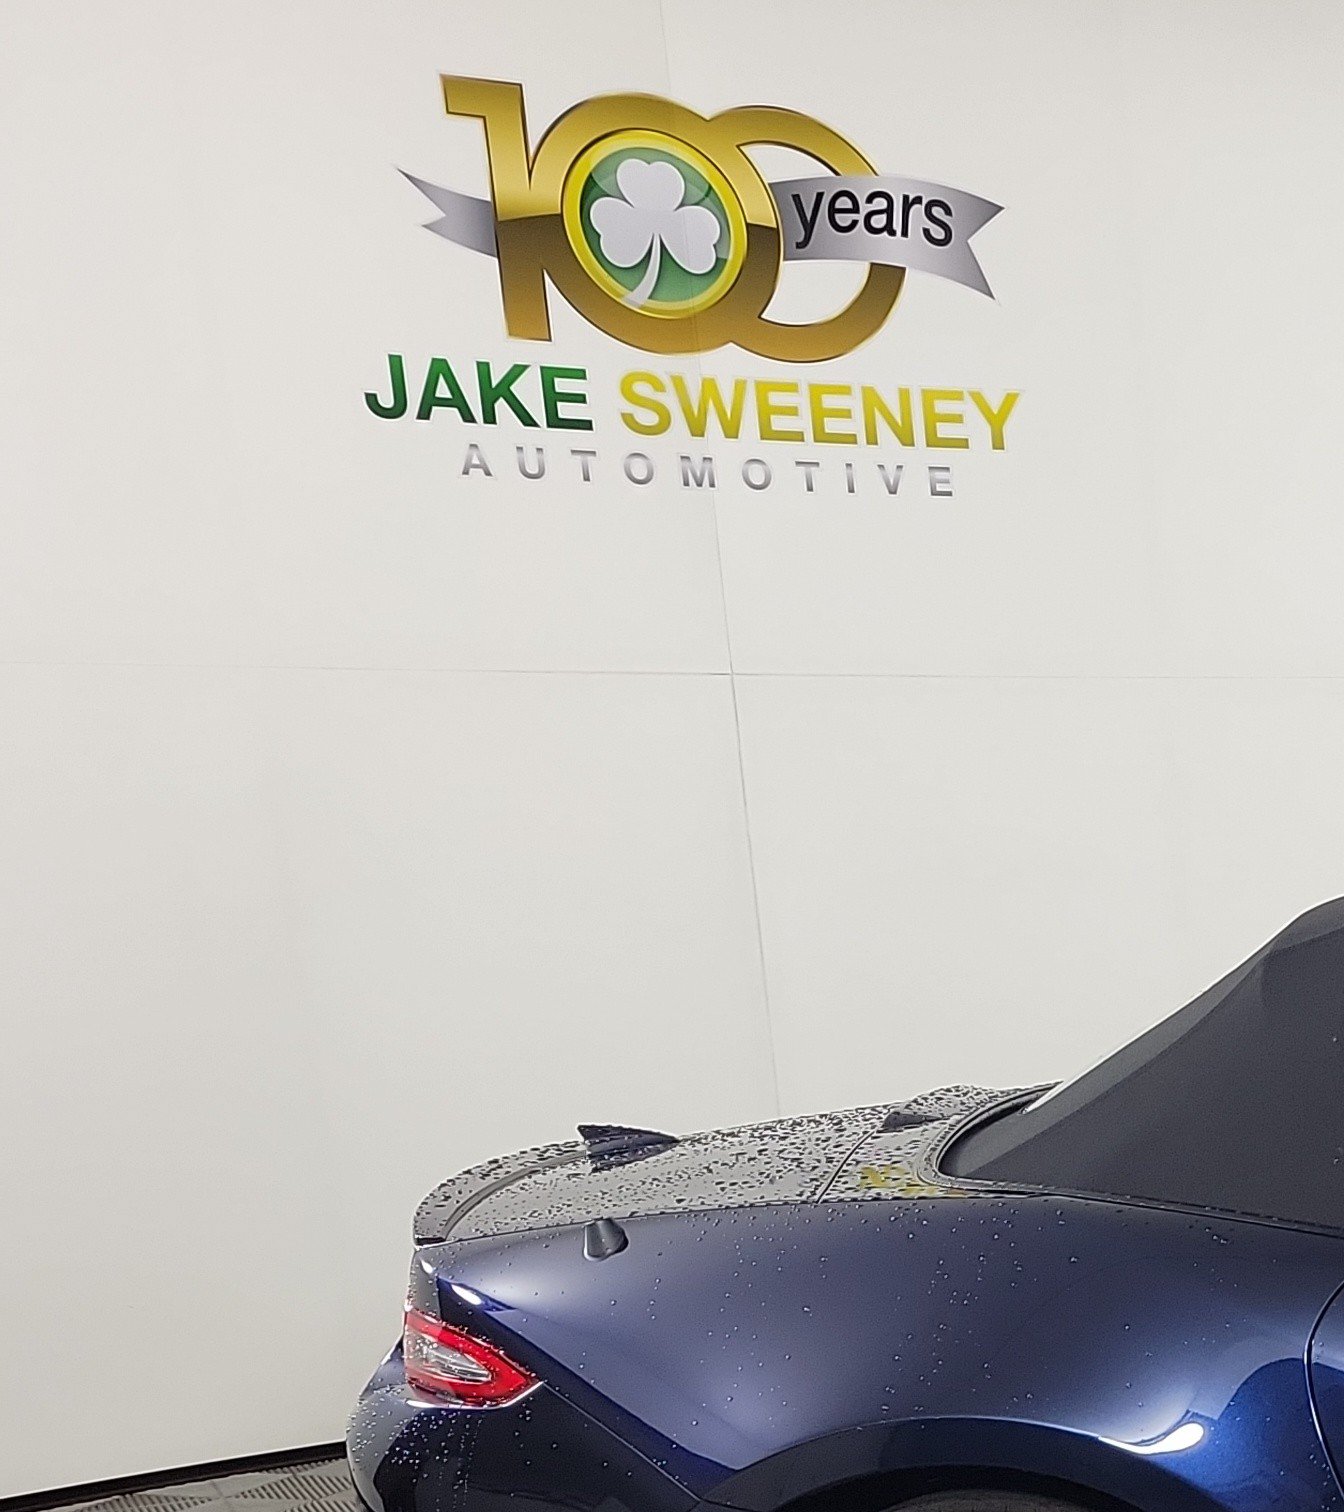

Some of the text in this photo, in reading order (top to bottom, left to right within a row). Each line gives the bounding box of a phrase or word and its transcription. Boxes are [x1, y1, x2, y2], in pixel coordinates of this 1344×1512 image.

[791, 187, 954, 250] years
[364, 353, 1022, 452] JAKE SWEENEY
[460, 442, 955, 498] AUTOMOTIVE
